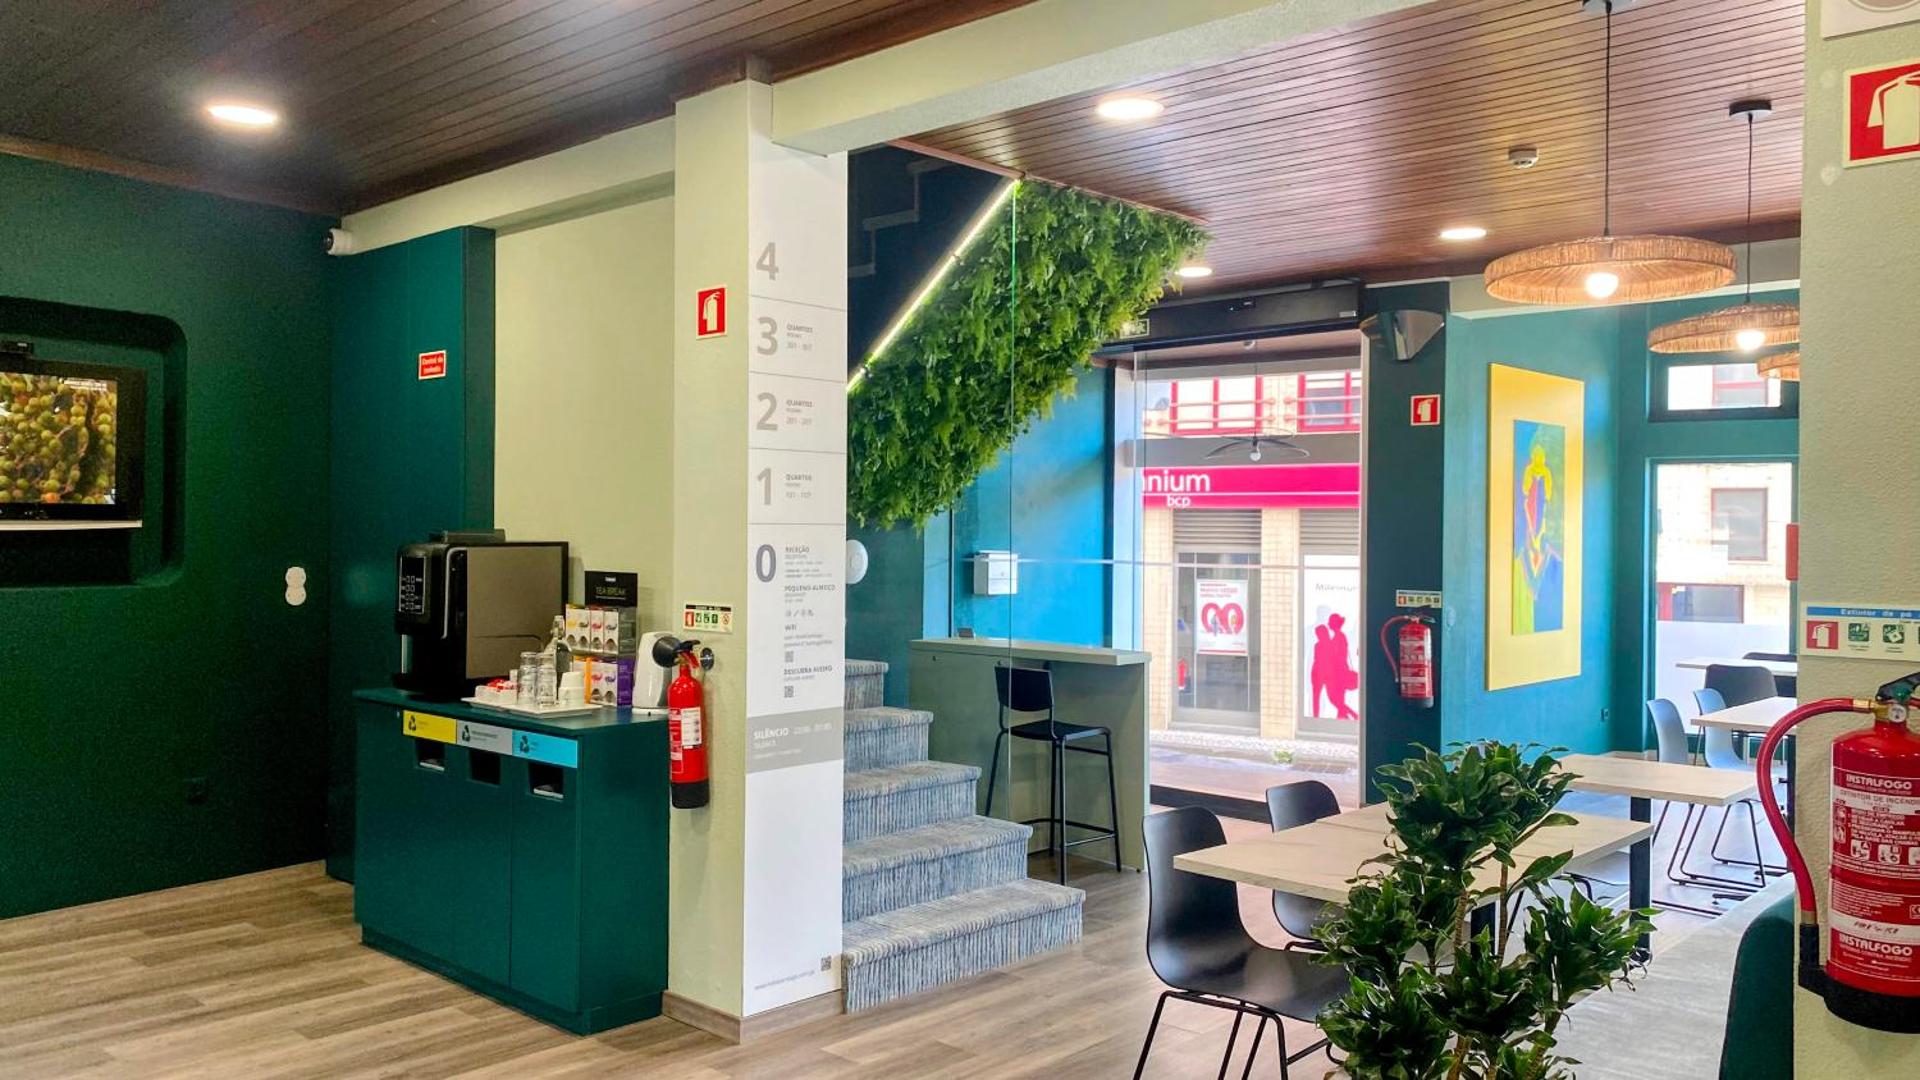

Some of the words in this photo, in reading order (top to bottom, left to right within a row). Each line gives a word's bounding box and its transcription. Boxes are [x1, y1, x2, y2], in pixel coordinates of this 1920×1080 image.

[756, 242, 779, 281] 4
[757, 317, 778, 355] 3
[756, 392, 778, 431] 2
[757, 467, 772, 506] 1
[1167, 494, 1191, 508] bcp
[756, 544, 776, 582] 0
[1846, 773, 1912, 790] INSTALFOGO
[1839, 932, 1913, 956] INSTALFOGO
